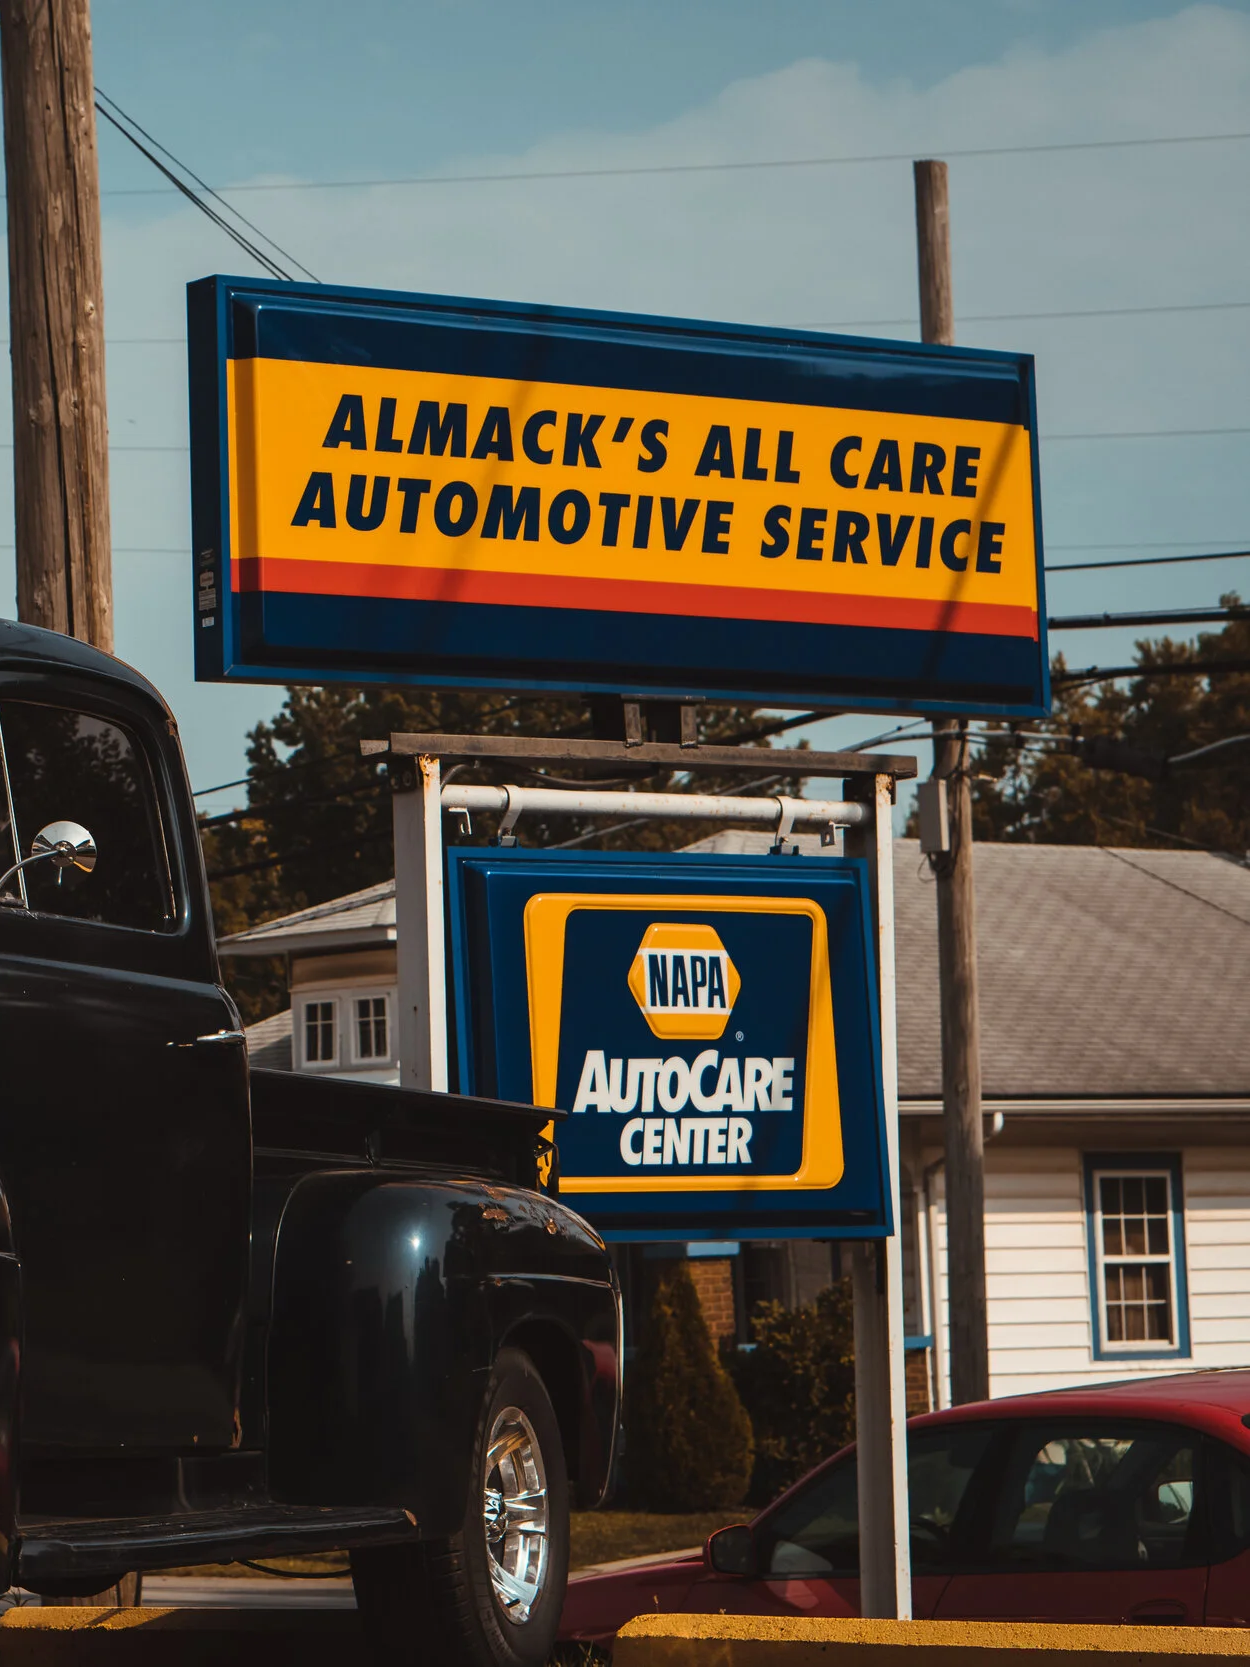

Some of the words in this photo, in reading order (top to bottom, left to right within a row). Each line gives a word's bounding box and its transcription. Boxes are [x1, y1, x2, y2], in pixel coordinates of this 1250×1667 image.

[322, 393, 669, 473] ALMACK'S
[694, 424, 801, 484] ALL
[829, 435, 981, 498] CARE
[290, 471, 734, 555] AUTOMOTIVE
[760, 504, 1006, 574] SERVICE
[647, 953, 727, 1010] NAPA
[572, 1049, 795, 1113] AUTOCARE
[619, 1117, 753, 1166] CENTER
